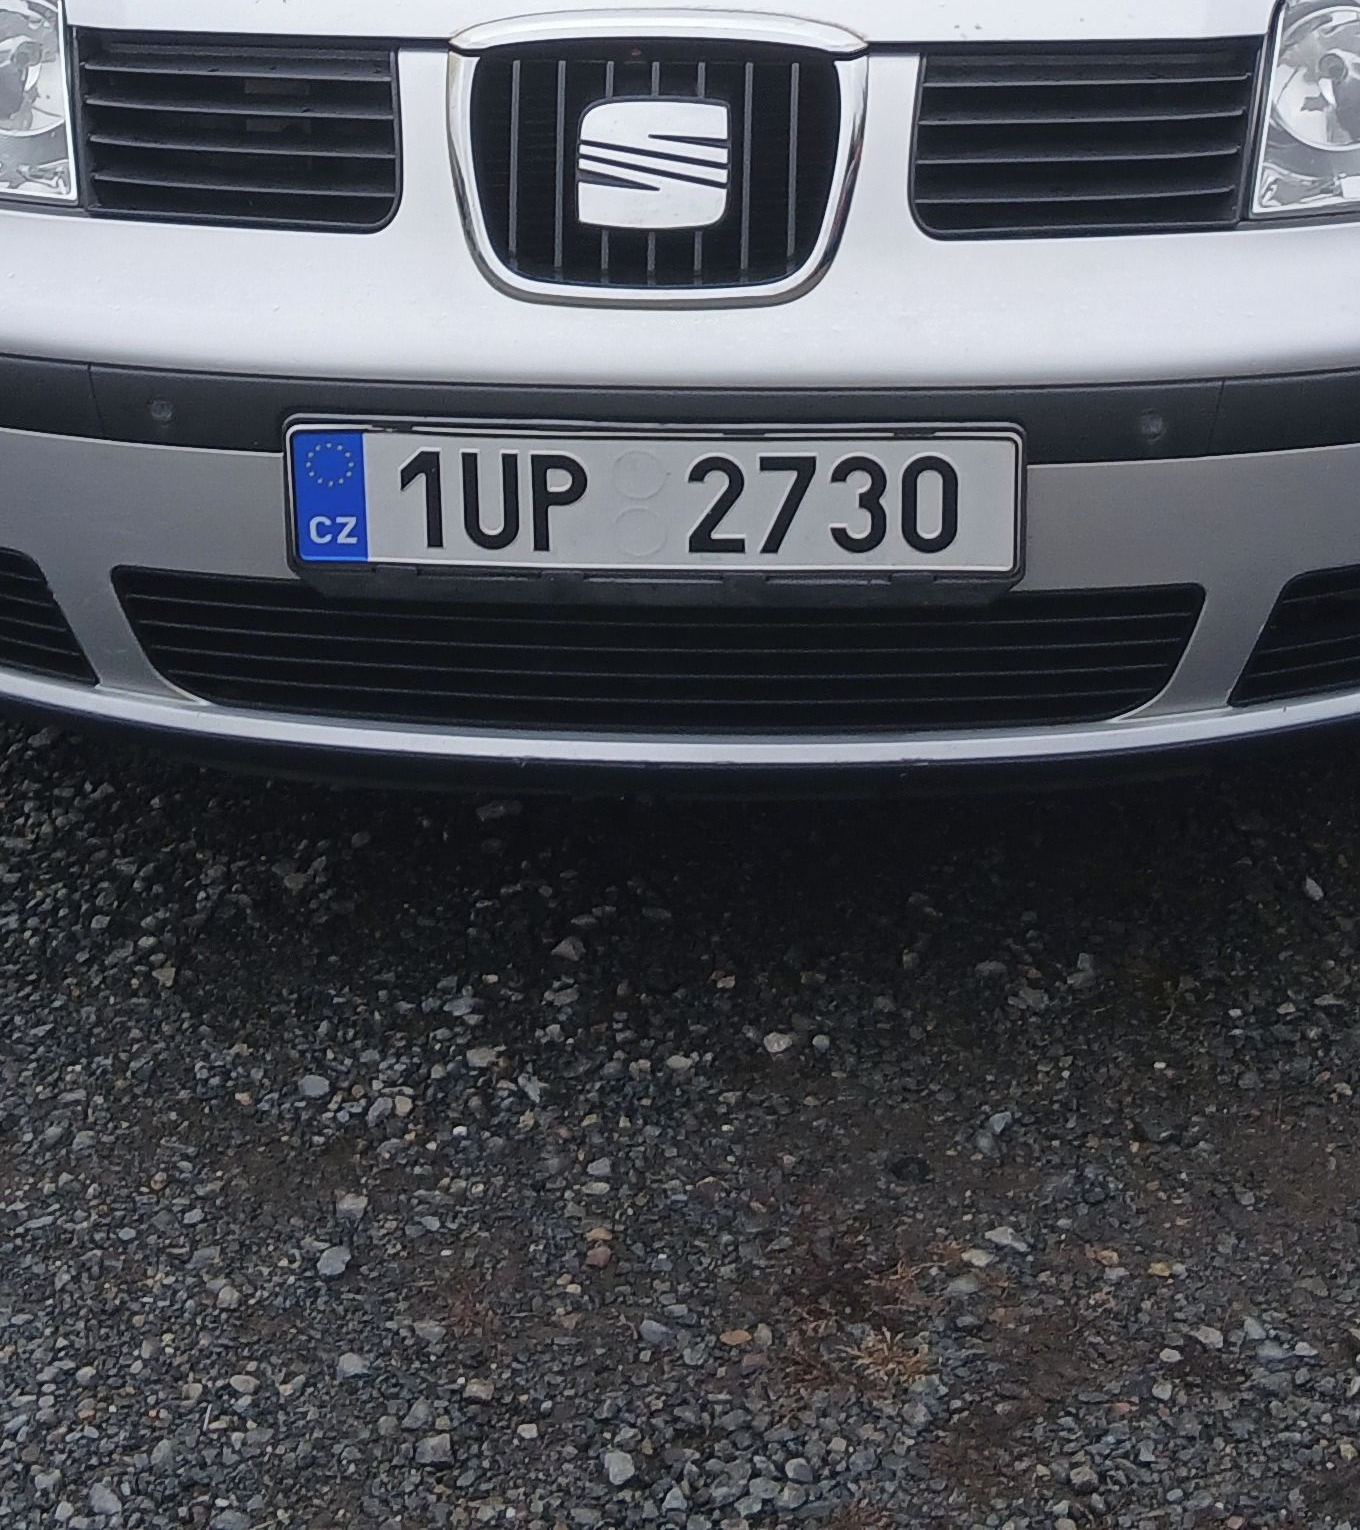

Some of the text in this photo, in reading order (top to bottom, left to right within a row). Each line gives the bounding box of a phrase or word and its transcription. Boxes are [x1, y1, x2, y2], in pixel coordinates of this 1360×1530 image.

[308, 515, 359, 546] CZ
[399, 446, 960, 556] 1UP 2730
